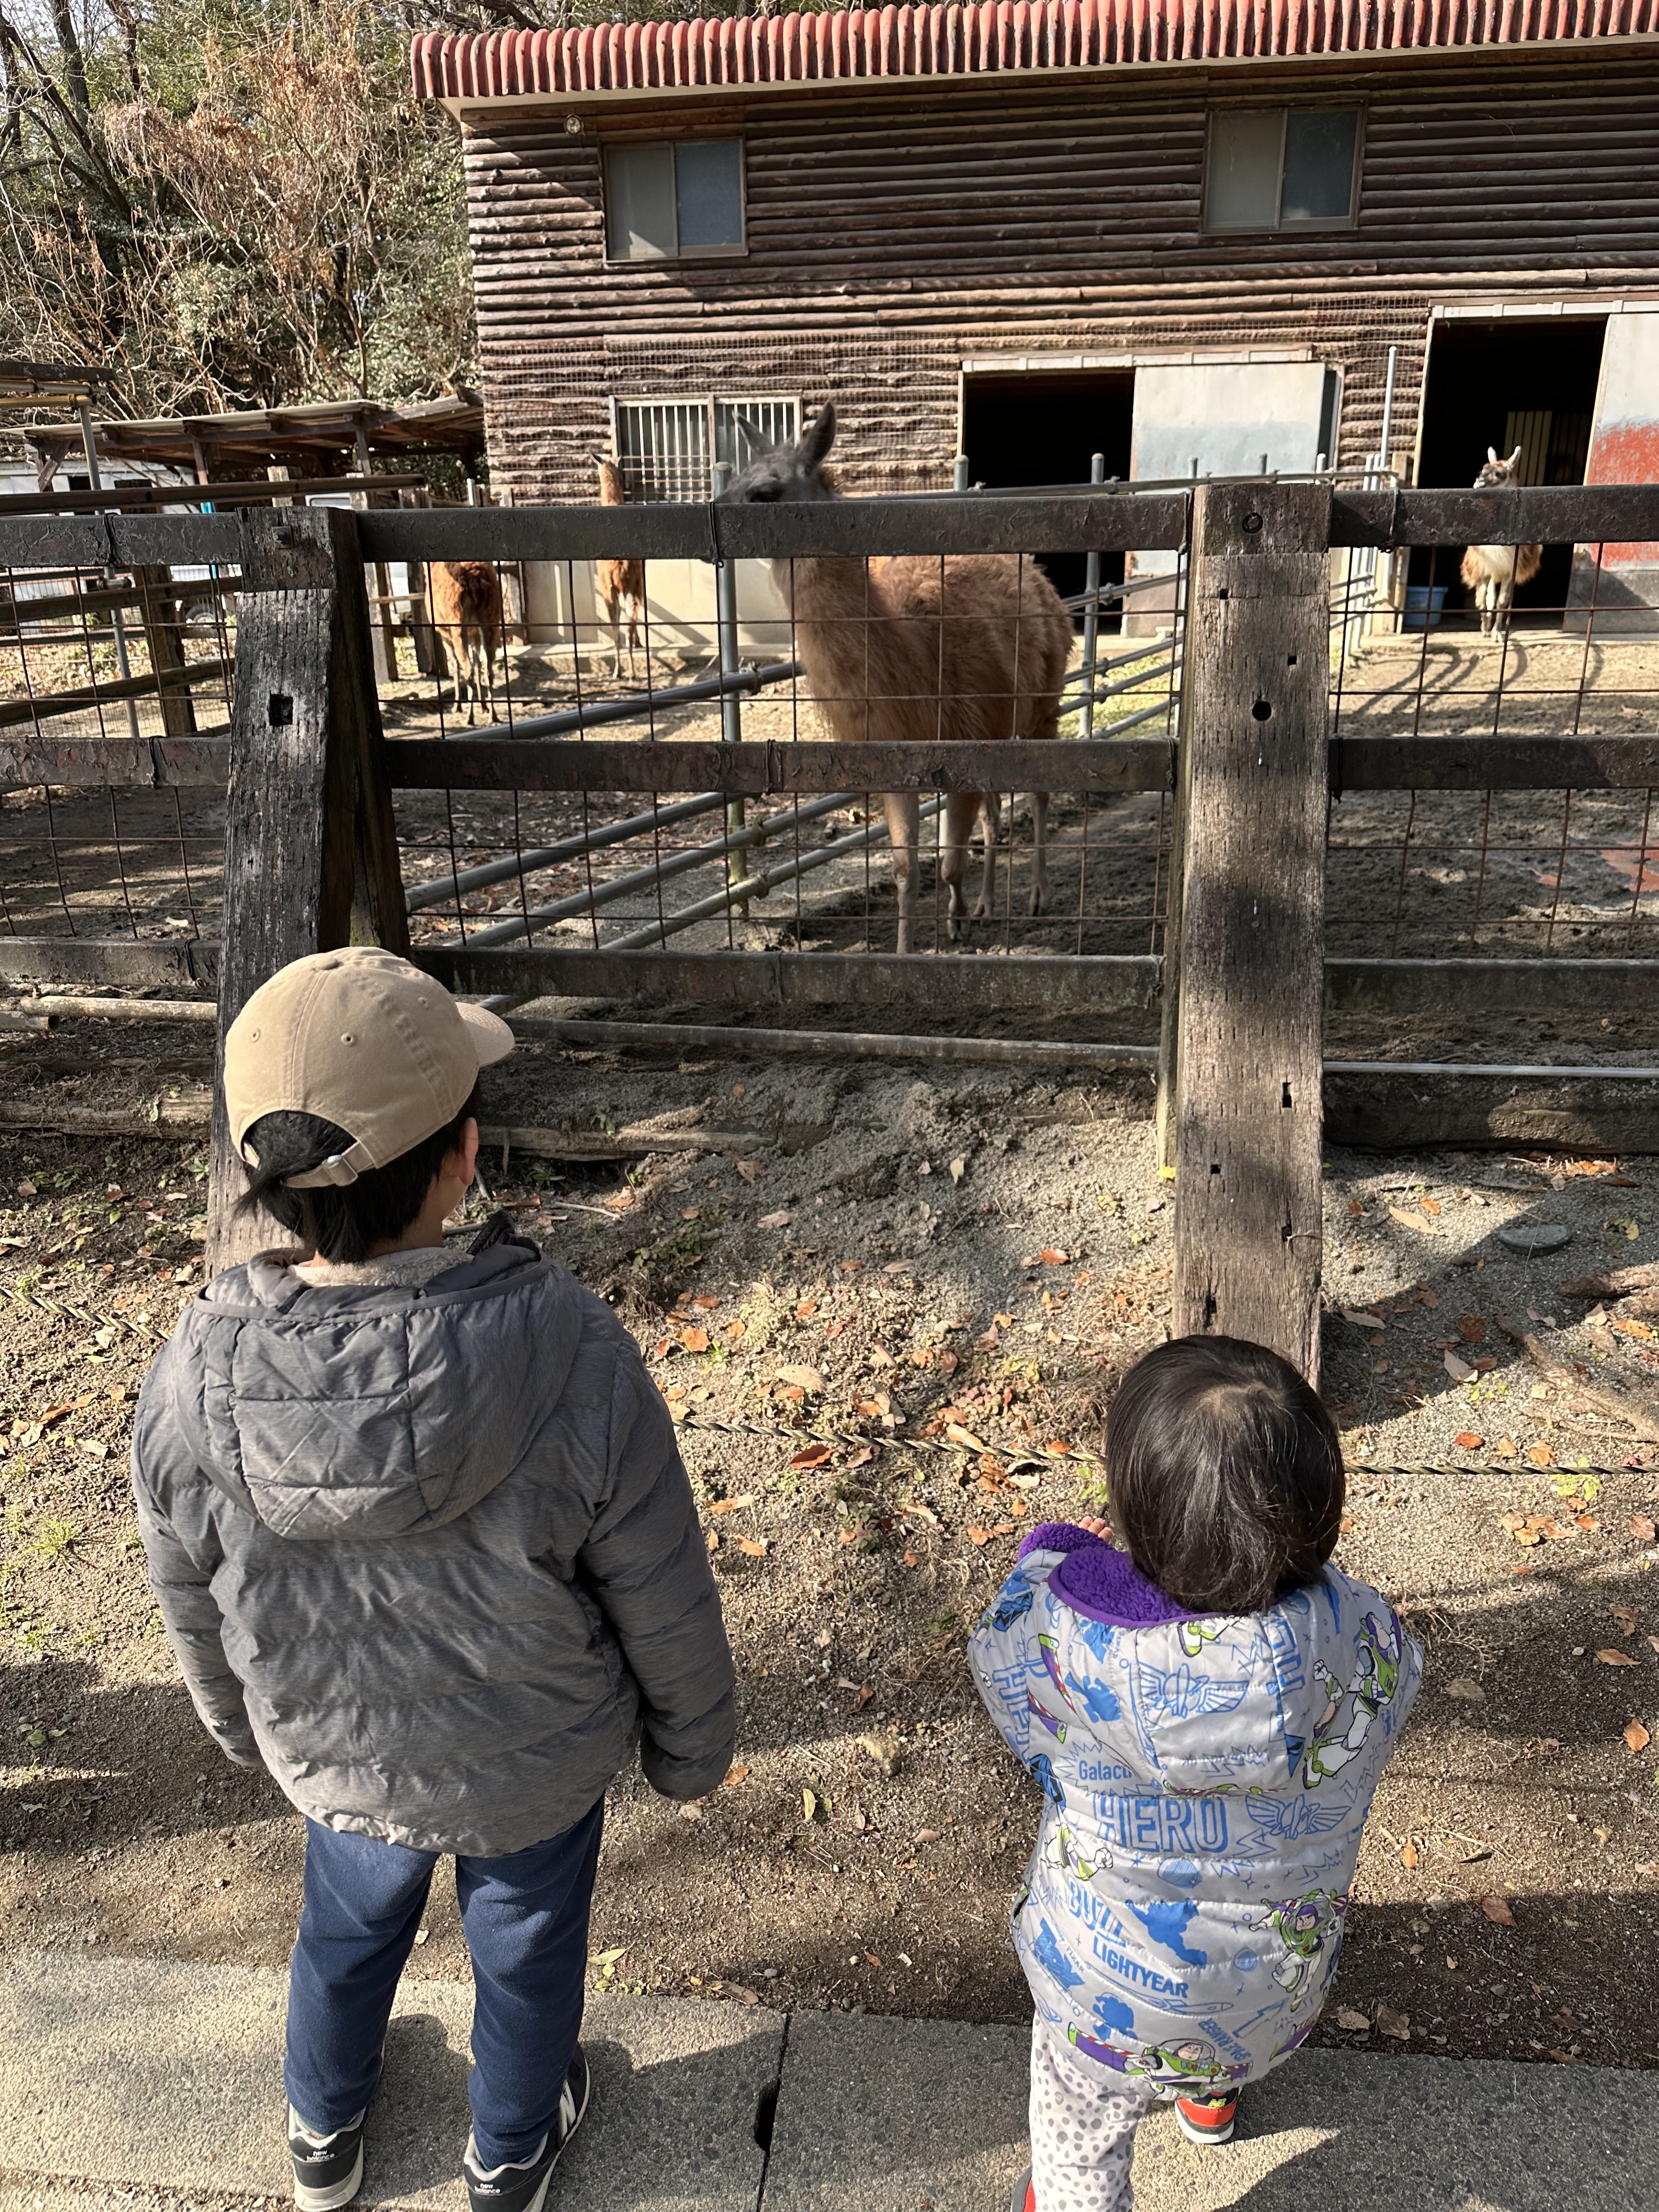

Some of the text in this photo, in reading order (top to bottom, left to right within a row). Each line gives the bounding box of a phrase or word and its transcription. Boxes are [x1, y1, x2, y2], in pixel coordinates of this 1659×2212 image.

[1092, 1795, 1228, 1854] HERO
[1066, 1945, 1084, 1973] PIXAR
[1093, 1935, 1189, 1999] LIGHTYEAR
[474, 2185, 500, 2194] balance
